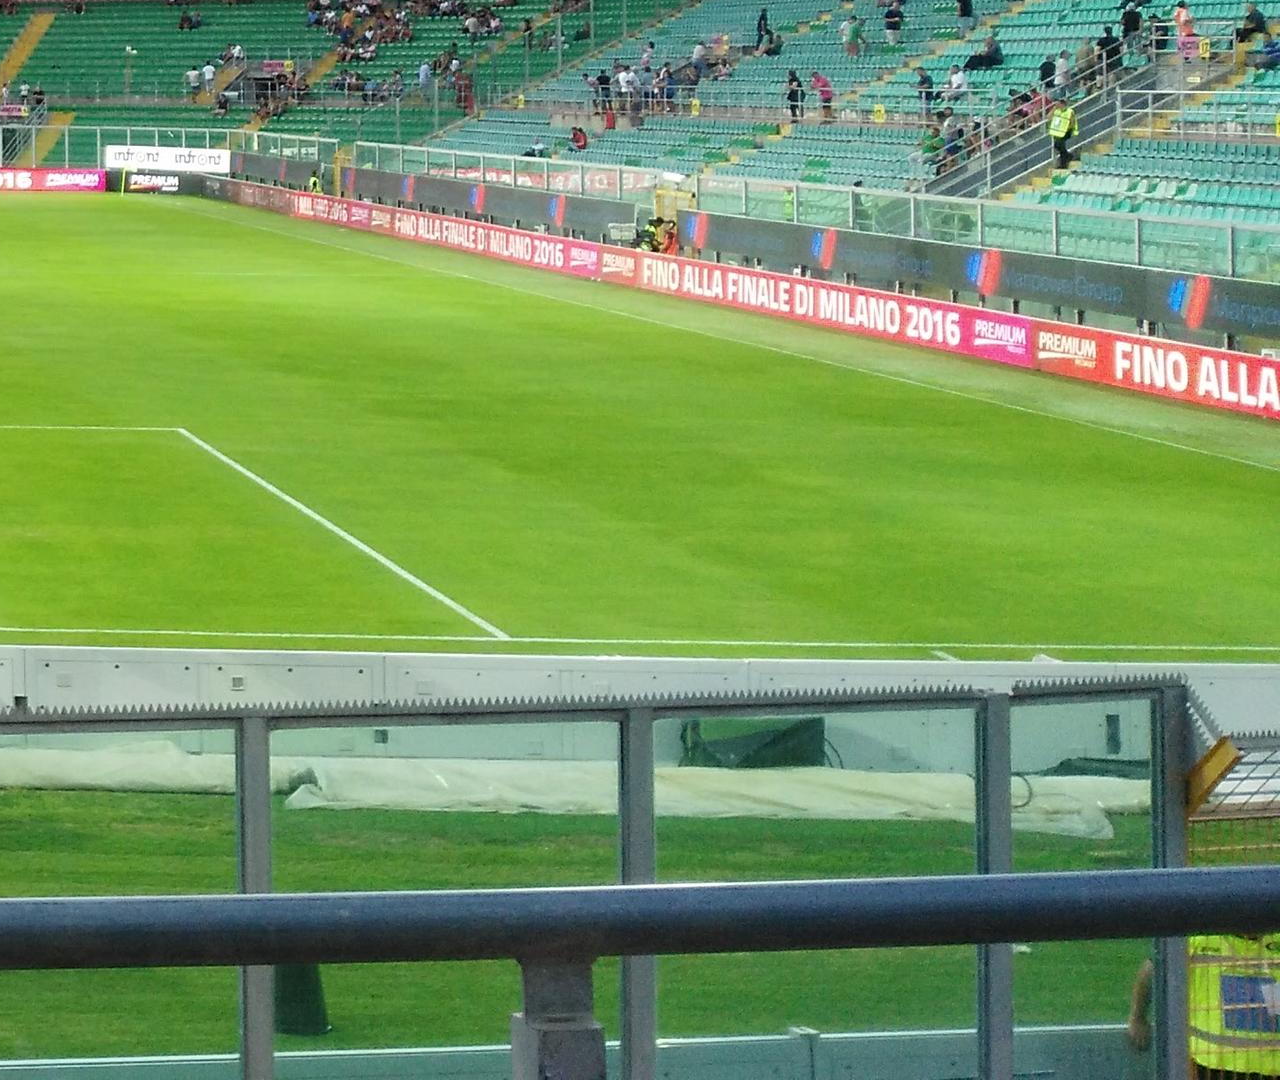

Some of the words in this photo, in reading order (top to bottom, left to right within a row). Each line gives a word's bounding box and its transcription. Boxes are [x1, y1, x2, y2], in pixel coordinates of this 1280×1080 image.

[130, 175, 179, 187] PREMIUM
[395, 213, 417, 237] FINO
[417, 217, 442, 243] ALLA
[442, 221, 476, 250] FINALE
[489, 229, 532, 260] MILANO
[534, 238, 564, 268] 2016
[570, 247, 598, 262] PREMIUM
[602, 252, 636, 268] PREMIUM
[642, 257, 680, 291] FINO
[682, 264, 724, 300] ALLA
[726, 271, 790, 313] FINALE
[794, 285, 815, 318] DI
[819, 289, 901, 334] MILANO
[905, 304, 961, 346] 2016
[973, 319, 1026, 345] PREMIUM
[1038, 331, 1097, 357] PREMIUM
[1114, 342, 1188, 393] FINO
[1197, 359, 1280, 411] ALLA
